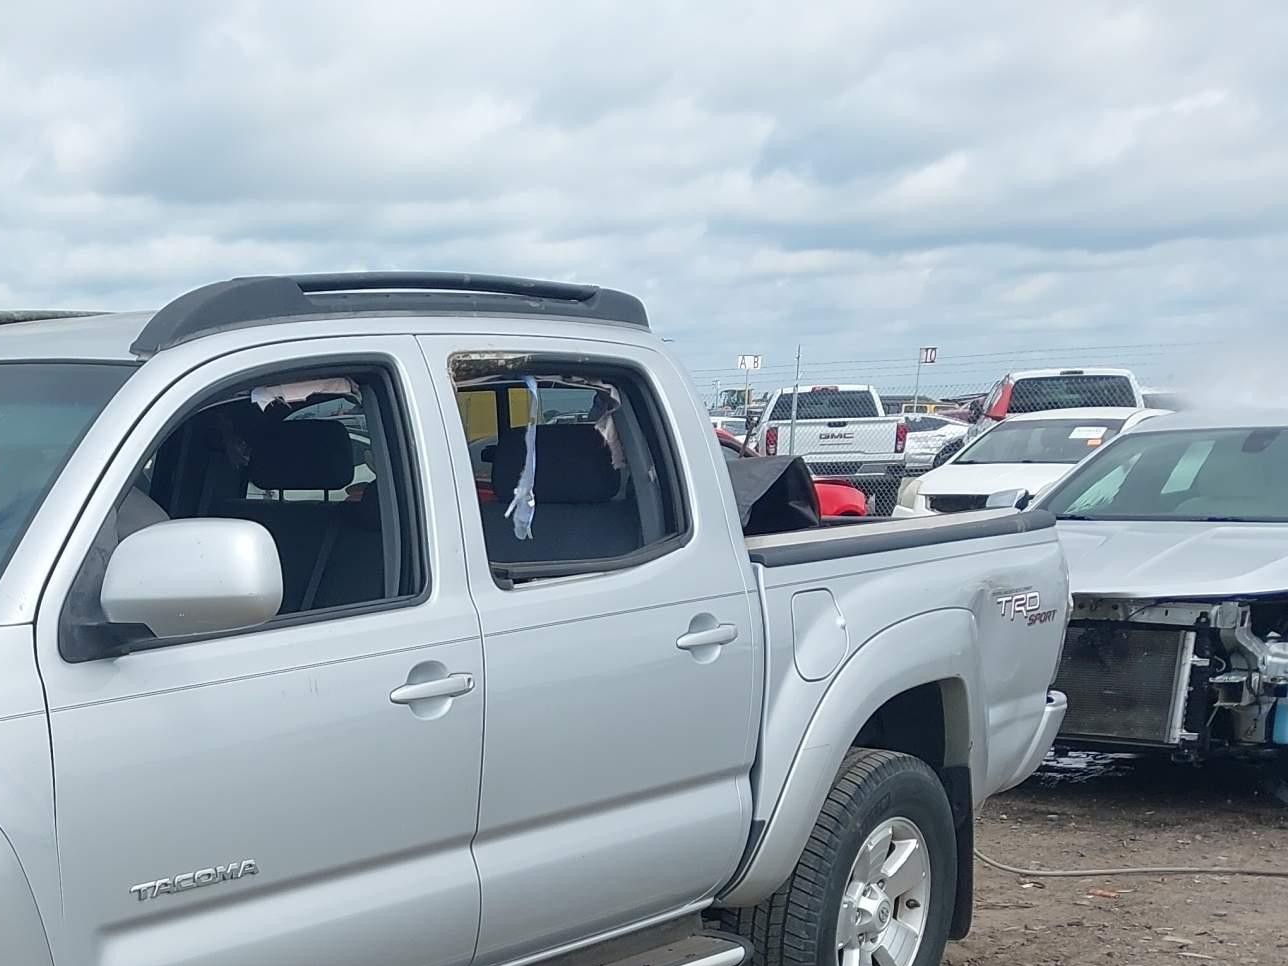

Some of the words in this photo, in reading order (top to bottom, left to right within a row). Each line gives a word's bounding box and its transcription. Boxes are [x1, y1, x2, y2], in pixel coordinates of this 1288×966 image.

[739, 355, 747, 369] A
[753, 355, 759, 369] B
[924, 348, 937, 363] 10
[996, 591, 1040, 621] TRD
[1027, 610, 1057, 626] SPORT
[129, 859, 259, 901] TACOMA
